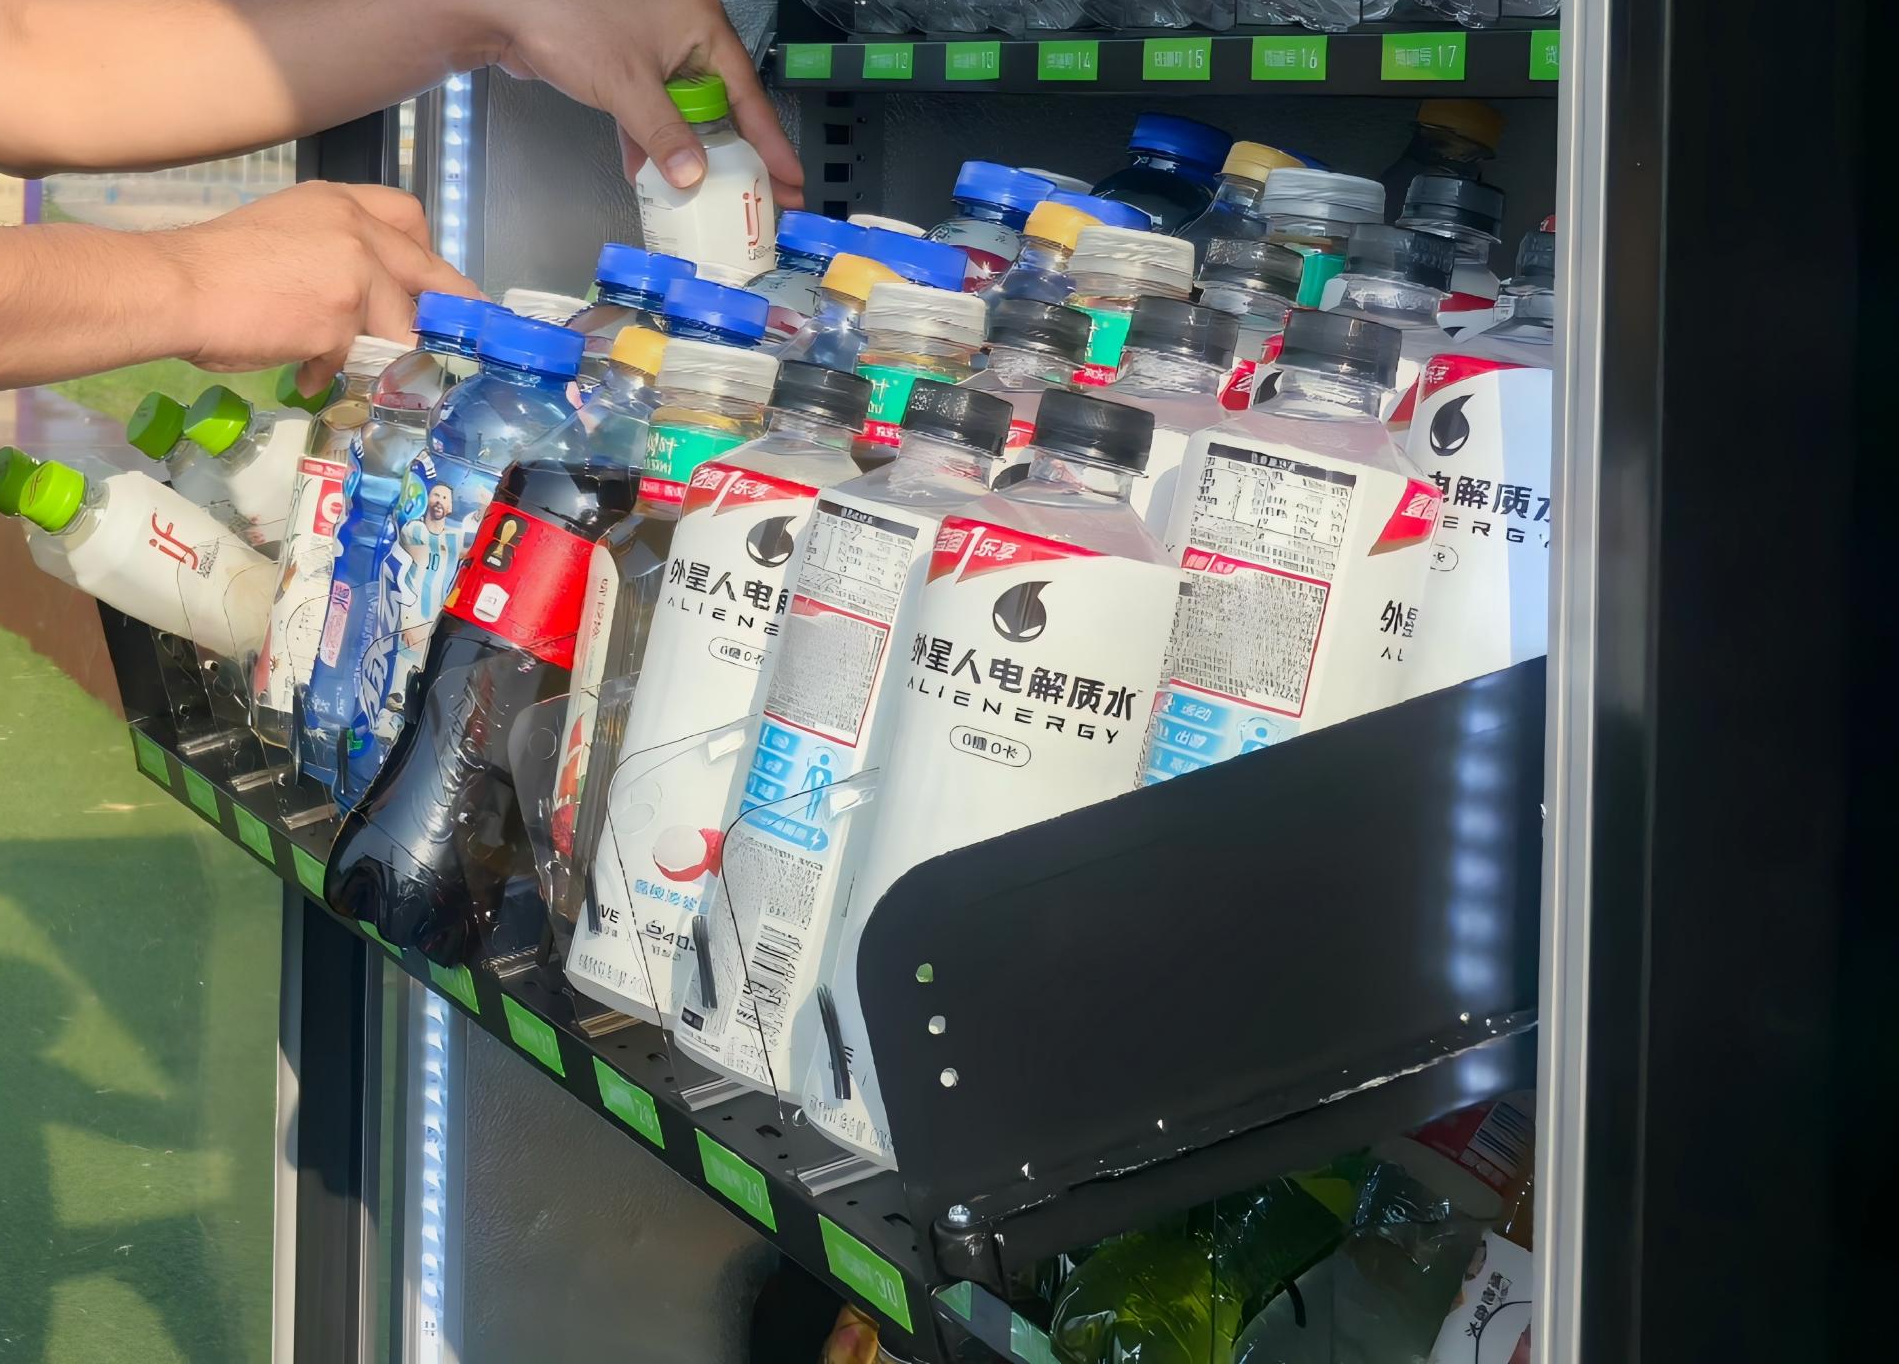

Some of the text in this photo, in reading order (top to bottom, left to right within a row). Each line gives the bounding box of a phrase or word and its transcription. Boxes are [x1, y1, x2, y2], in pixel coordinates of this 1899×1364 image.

[907, 675, 1119, 744] ALIENERGY
[910, 632, 1137, 721] 外星人电解质水
